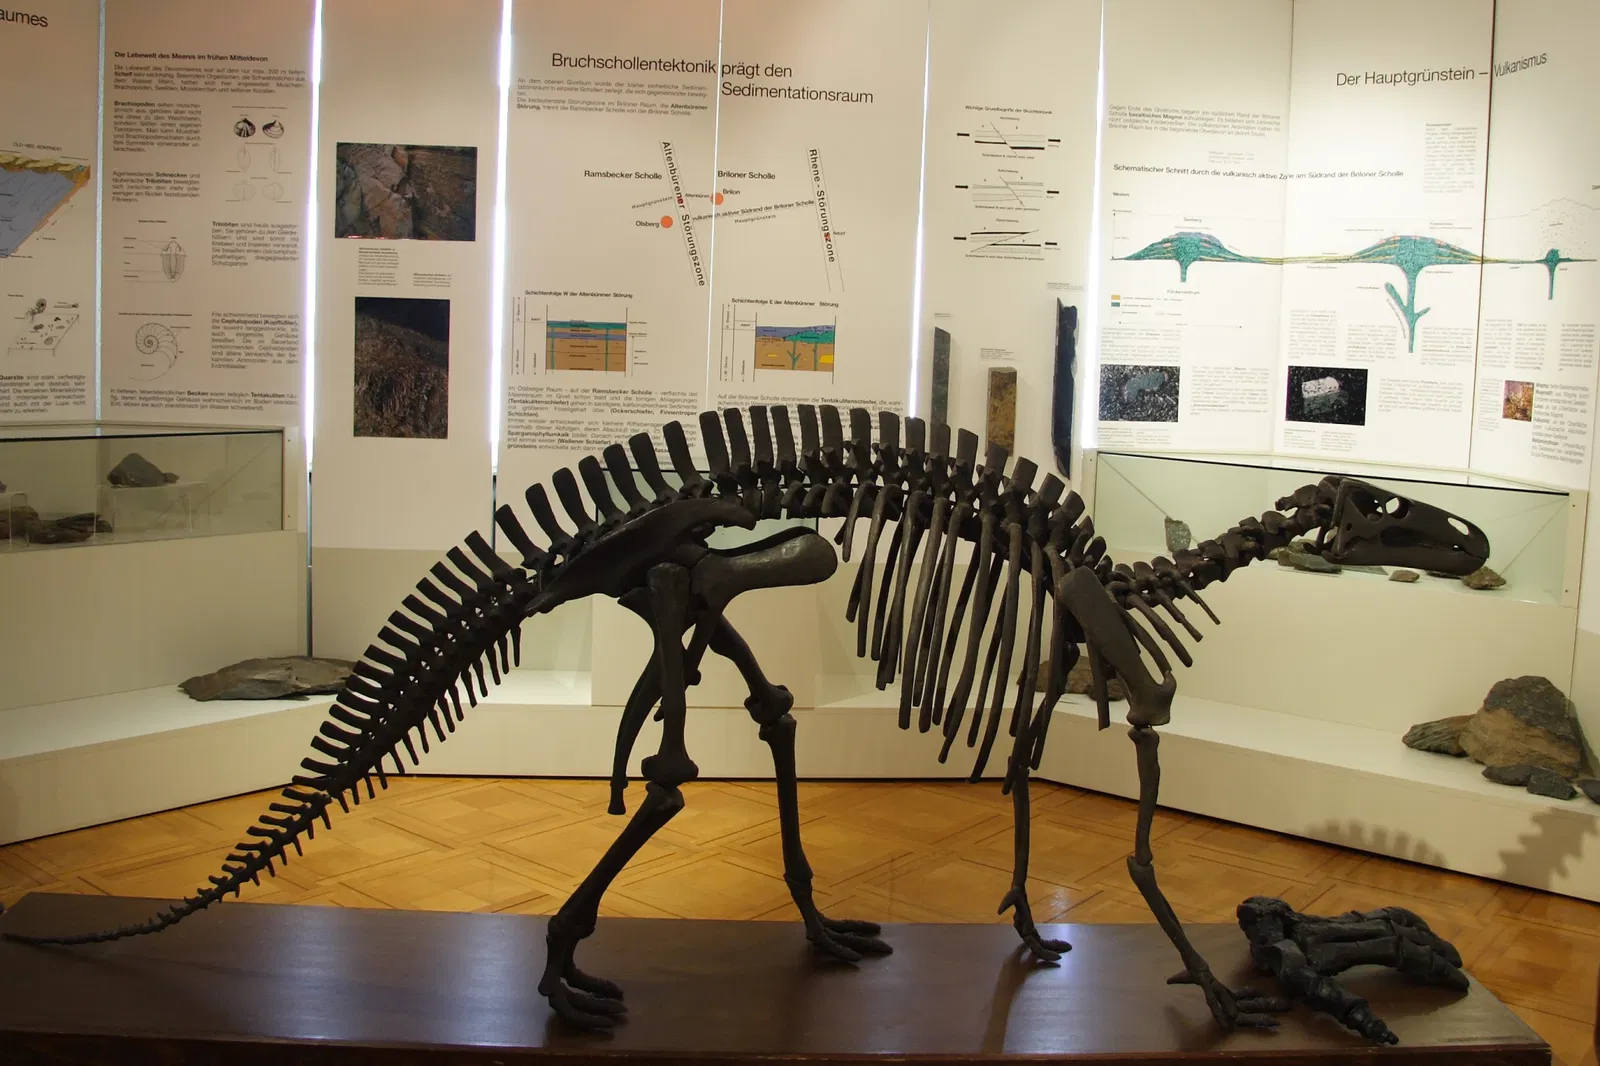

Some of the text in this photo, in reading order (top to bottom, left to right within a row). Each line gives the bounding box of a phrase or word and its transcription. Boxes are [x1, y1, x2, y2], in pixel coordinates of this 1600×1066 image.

[0, 9, 48, 27] aumes
[552, 53, 792, 79] Bruchschollentektonik prägt den
[1336, 72, 1360, 86] Der
[1364, 66, 1474, 86] Hauptgrünstein
[1494, 52, 1547, 77] Vulkanismus
[722, 82, 873, 103] Sedimentationsraum
[584, 170, 632, 178] Ramsbecker
[748, 172, 775, 180] Scholle
[1114, 164, 1164, 173] Schematischer
[662, 141, 705, 286] Altenbürener Störungszone
[741, 206, 763, 215] Südrand
[809, 149, 820, 181] Rhene
[817, 190, 835, 262] Störungszone
